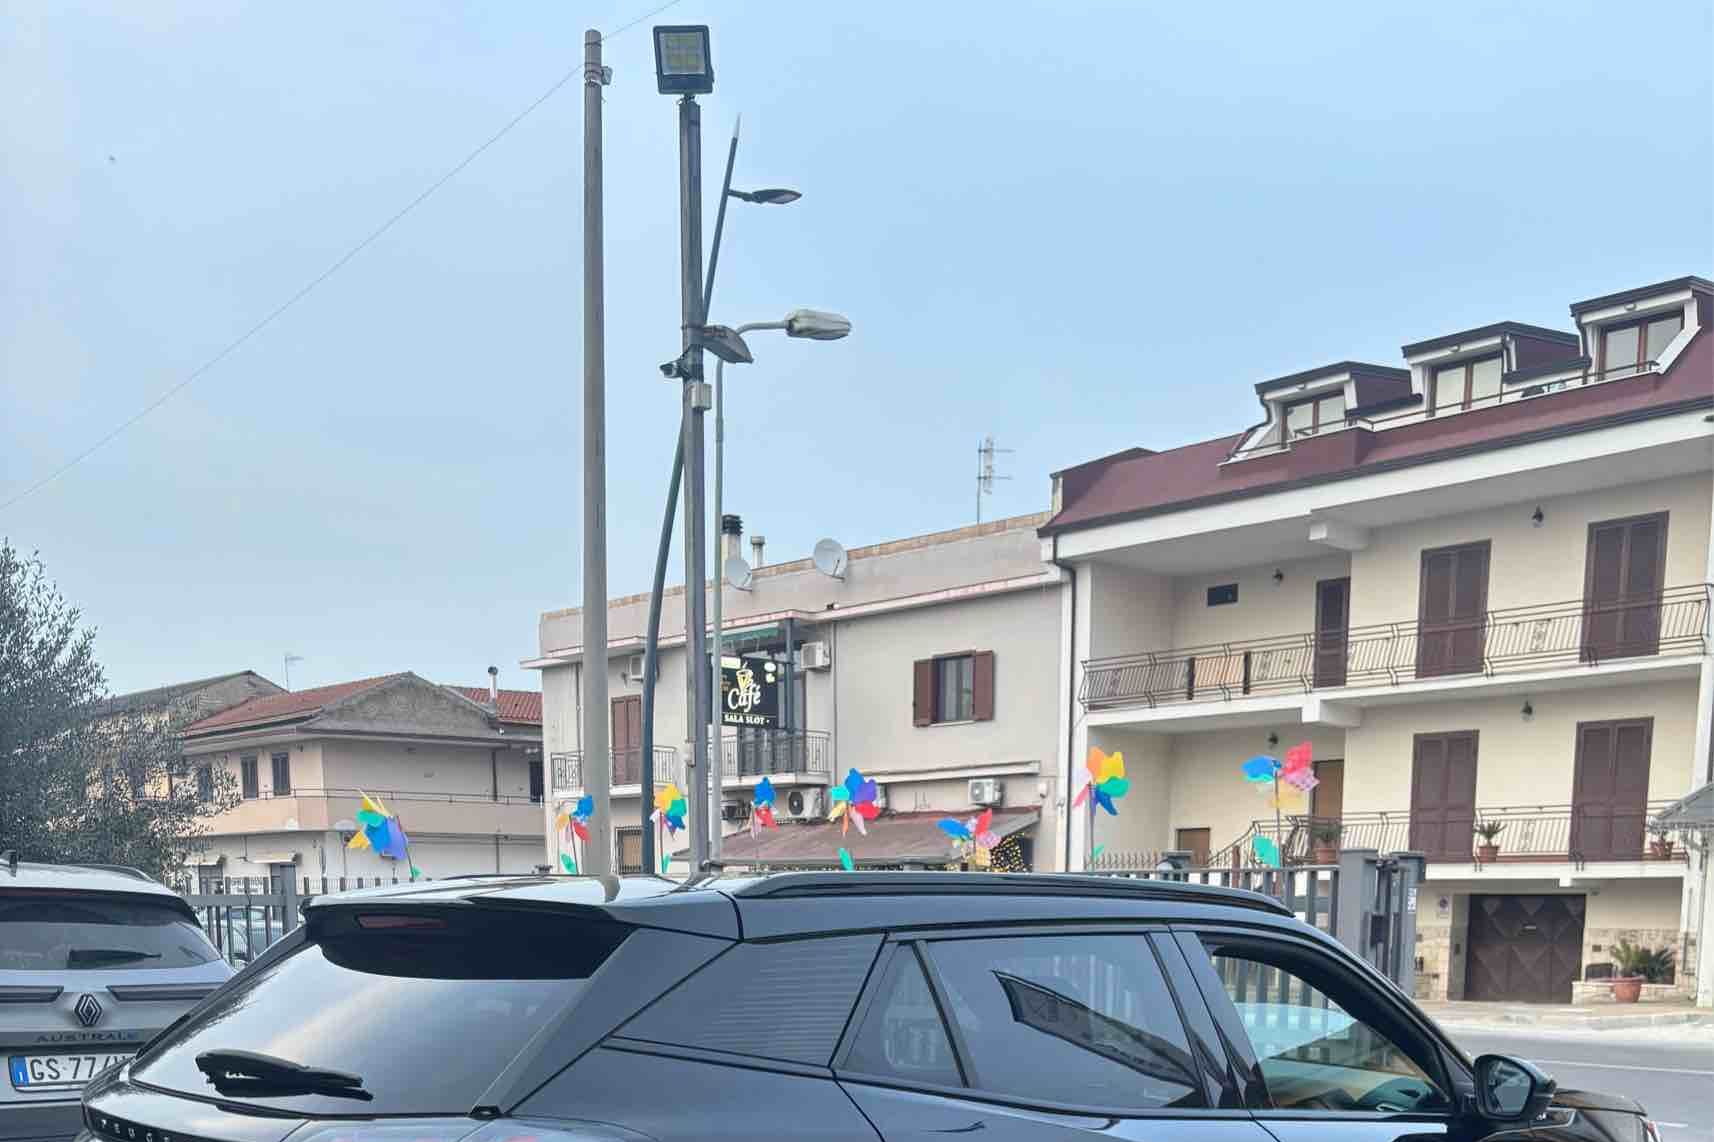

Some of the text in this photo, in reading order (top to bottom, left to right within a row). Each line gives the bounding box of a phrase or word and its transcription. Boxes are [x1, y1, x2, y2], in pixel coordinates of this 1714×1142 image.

[728, 683, 761, 713] Café
[724, 714, 765, 725] SALA SLOT
[30, 1058, 60, 1080] GS
